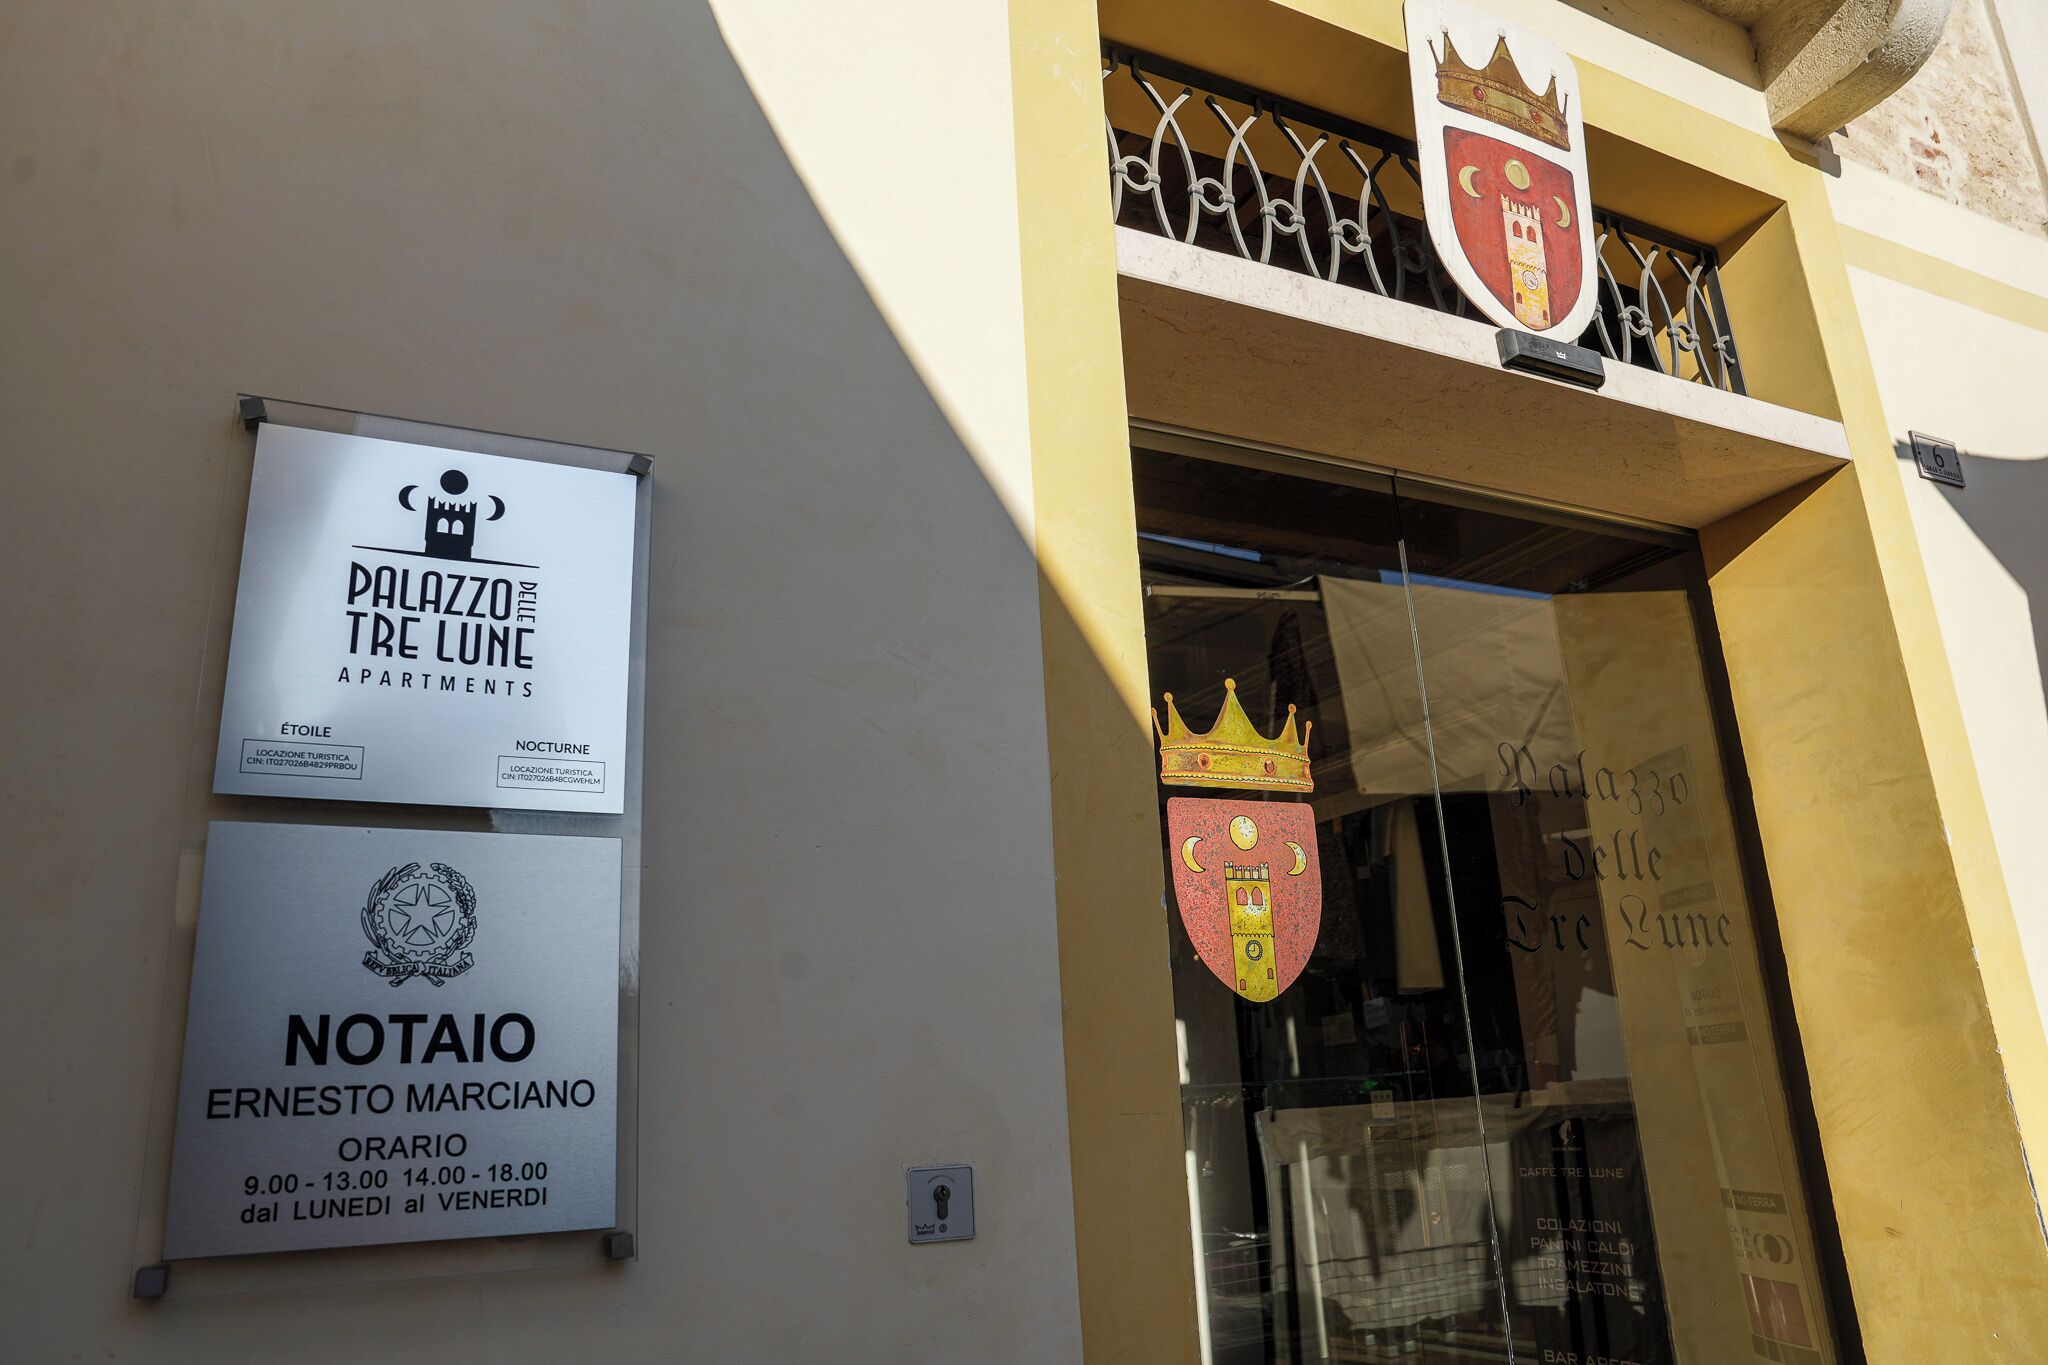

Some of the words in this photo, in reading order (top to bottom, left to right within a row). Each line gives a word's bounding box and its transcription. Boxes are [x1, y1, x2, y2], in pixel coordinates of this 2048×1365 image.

[1932, 445, 1945, 469] 6
[347, 561, 513, 621] PALAZZO
[516, 581, 538, 623] DELLE
[346, 610, 421, 660] TRE
[437, 620, 535, 670] LUNE
[338, 667, 532, 698] APARTMENTS
[281, 722, 332, 738] ÉTOILE
[256, 749, 305, 759] LOCAZIONE
[307, 752, 350, 762] TURISTICA
[516, 740, 590, 755] NOCTURNE
[246, 757, 264, 765] CIN:
[510, 765, 554, 775] LOCAZIONE
[555, 768, 593, 777] TURISTICA
[501, 772, 516, 780] CIN:
[1497, 742, 1688, 816] Palazzo
[1561, 826, 1663, 882] delle
[1501, 895, 1592, 953] Tre
[1619, 894, 1732, 951] Lune
[428, 960, 470, 977] ITALIANA
[285, 1012, 535, 1067] NOTAIO
[206, 1084, 394, 1120] ERNESTO
[406, 1079, 596, 1114] MARCIANO
[338, 1133, 467, 1162] ORARIO
[244, 1173, 298, 1196] 9.00
[322, 1169, 388, 1192] 13.00
[403, 1166, 465, 1188] 14.00
[487, 1162, 548, 1182] 18.00
[1561, 1167, 1583, 1178] TRE
[1589, 1167, 1624, 1179] LUNE
[241, 1202, 278, 1224] dal
[293, 1196, 390, 1221] LUNEDI
[404, 1193, 424, 1213] al
[438, 1187, 548, 1212] VENERDI
[1536, 1218, 1622, 1235] COLAZIONI
[1530, 1237, 1582, 1252] PANINI
[1587, 1241, 1634, 1256] CALDI
[1537, 1257, 1633, 1277] TRAMEZZINI
[1538, 1276, 1641, 1300] INSALATONE
[1543, 1349, 1578, 1365] BAR
